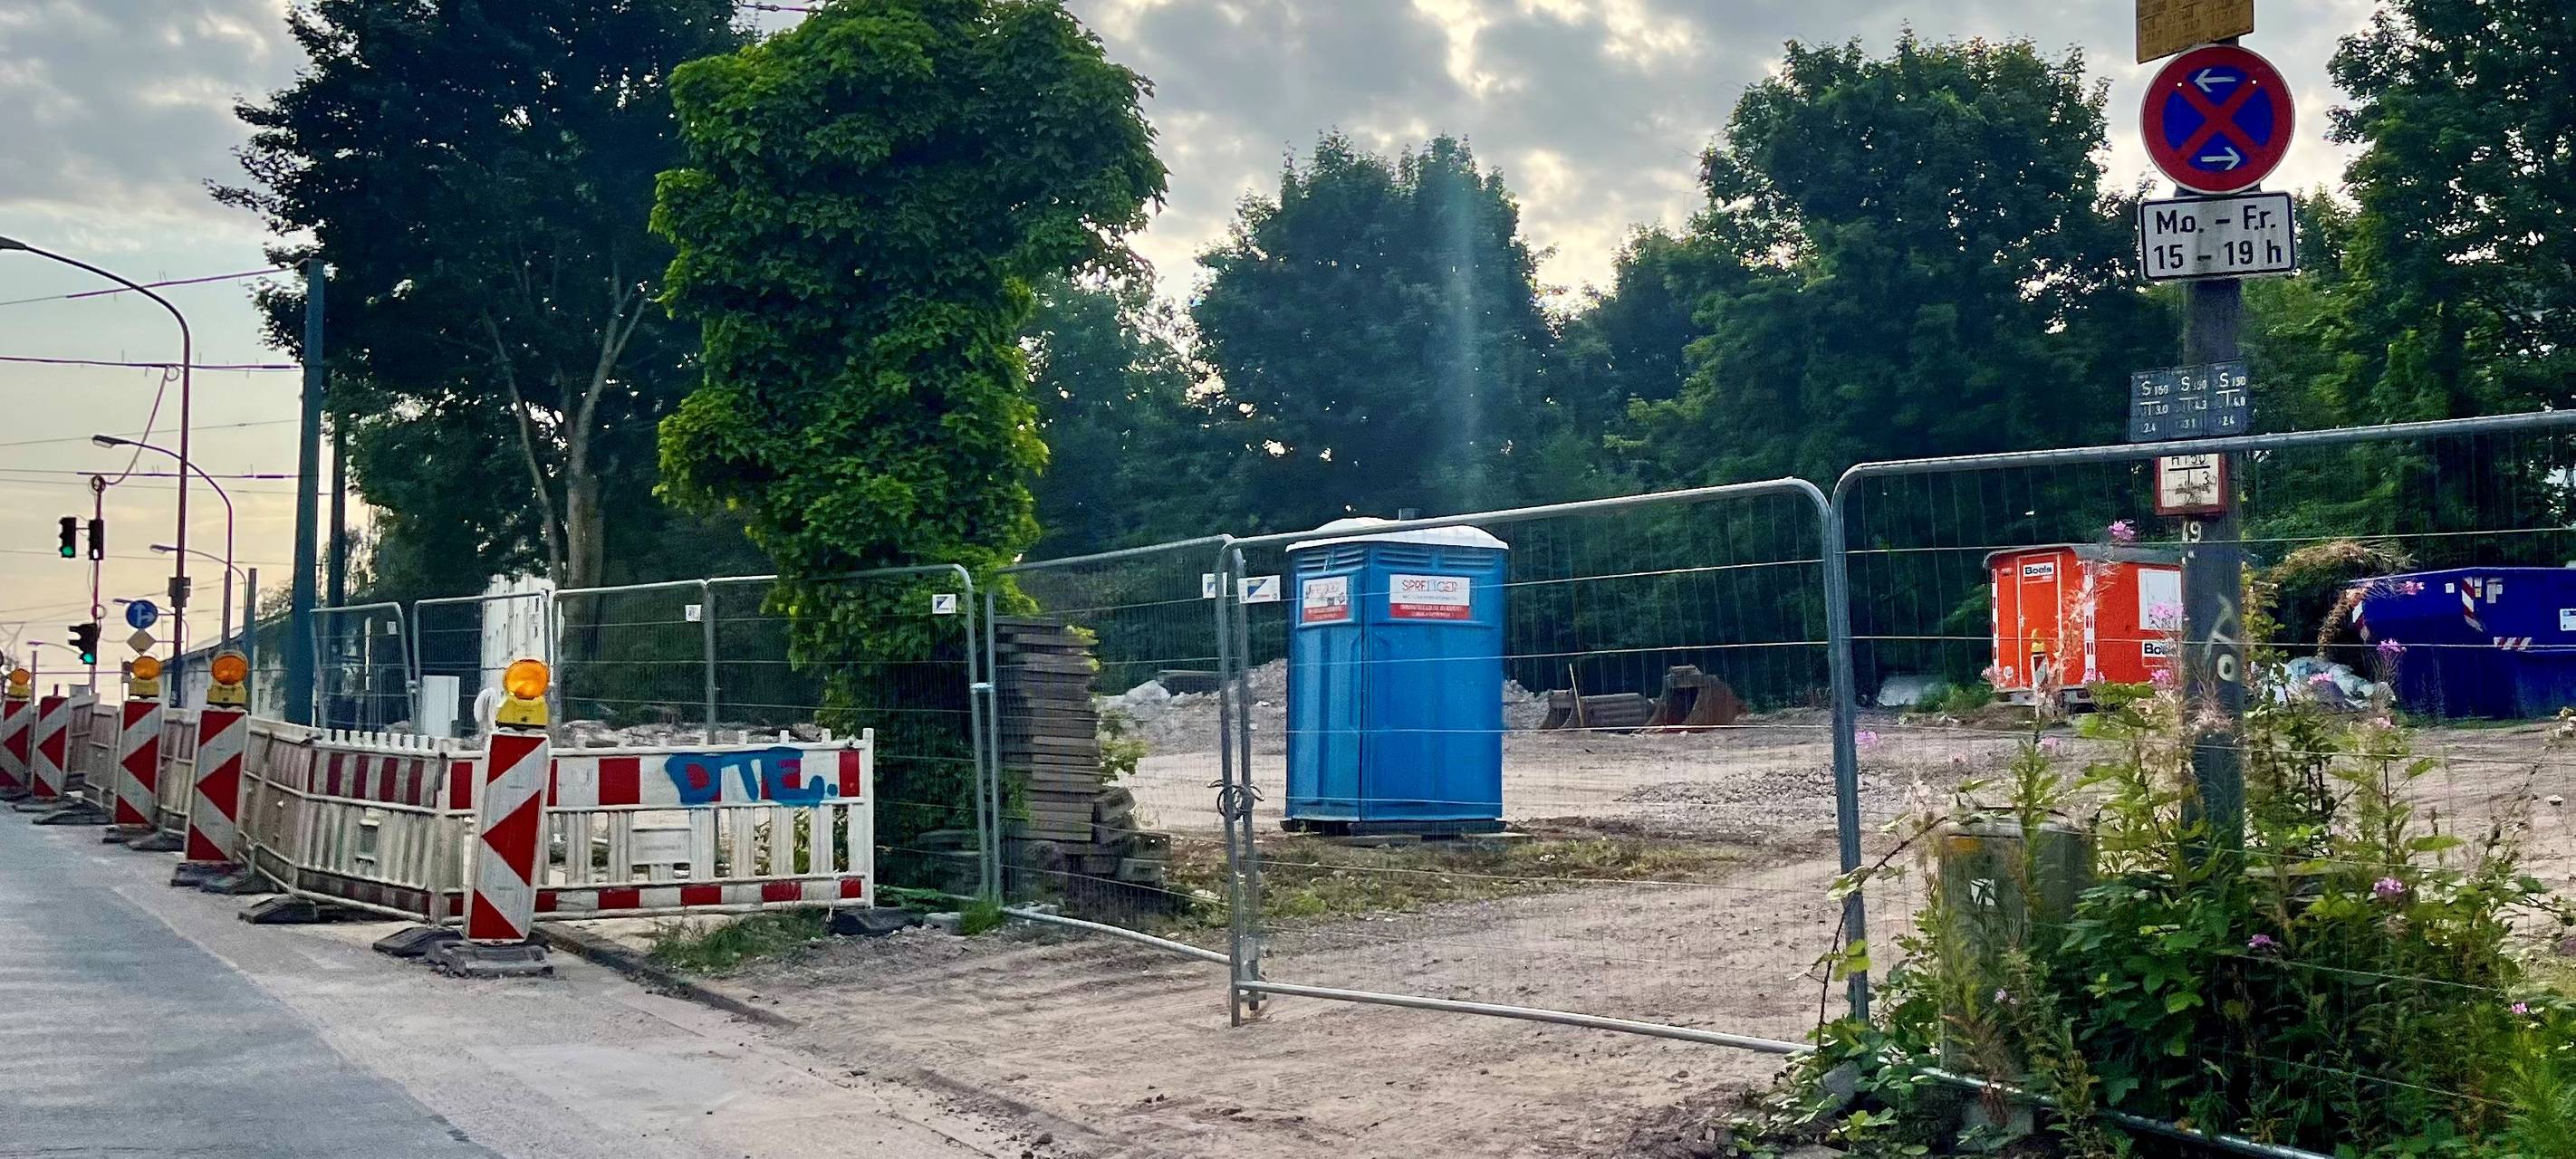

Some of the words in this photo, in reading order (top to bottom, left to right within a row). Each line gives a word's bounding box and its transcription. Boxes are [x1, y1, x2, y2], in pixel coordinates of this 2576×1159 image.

[2155, 210, 2205, 235] Mo.
[2243, 205, 2276, 231] Fr.
[2153, 244, 2185, 270] 15
[2224, 240, 2254, 266] 19
[2266, 238, 2282, 264] h
